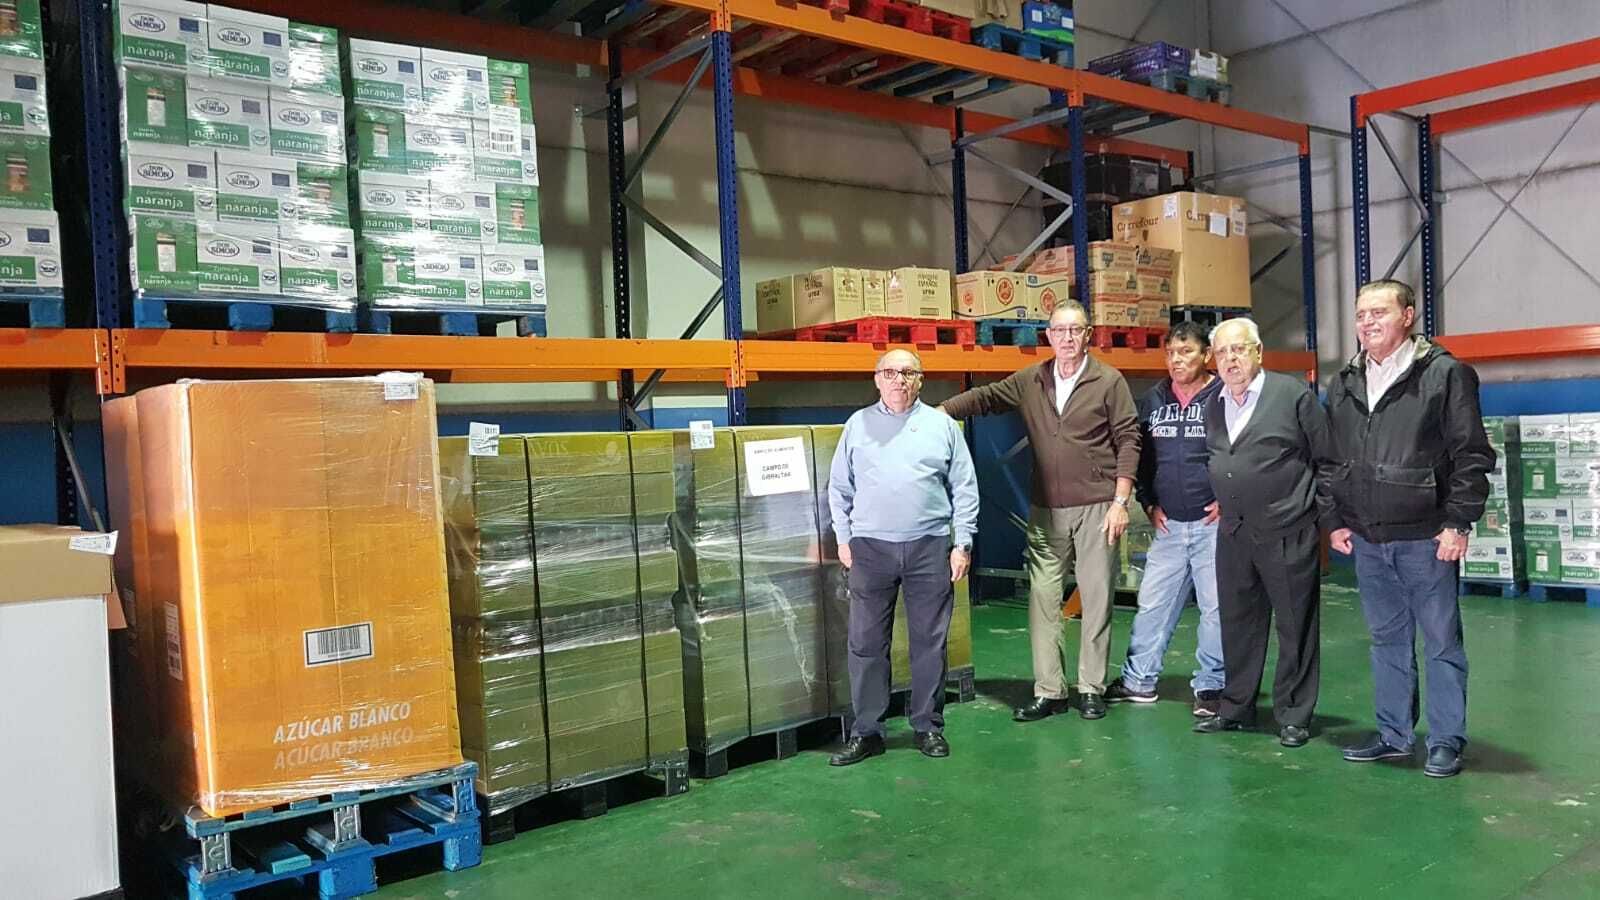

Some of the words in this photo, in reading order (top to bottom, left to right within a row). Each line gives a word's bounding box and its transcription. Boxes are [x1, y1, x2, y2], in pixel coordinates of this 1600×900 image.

[127, 45, 176, 60] naranja
[216, 58, 260, 73] naranja
[357, 87, 396, 99] naranja
[194, 128, 239, 142] naranja
[278, 138, 319, 152] naranja
[136, 195, 184, 209] naranja
[225, 203, 268, 216] naranja
[365, 220, 404, 231] naranja
[437, 223, 473, 234] naranja
[205, 271, 249, 285] naranja
[287, 276, 328, 287] naranja
[489, 287, 524, 297] naranja
[762, 464, 782, 472] CAMPO
[761, 471, 791, 481] GIBRALTAR
[273, 715, 343, 745] AZÚCAR
[348, 702, 411, 730] BLANCO
[346, 726, 414, 754] BRANCO
